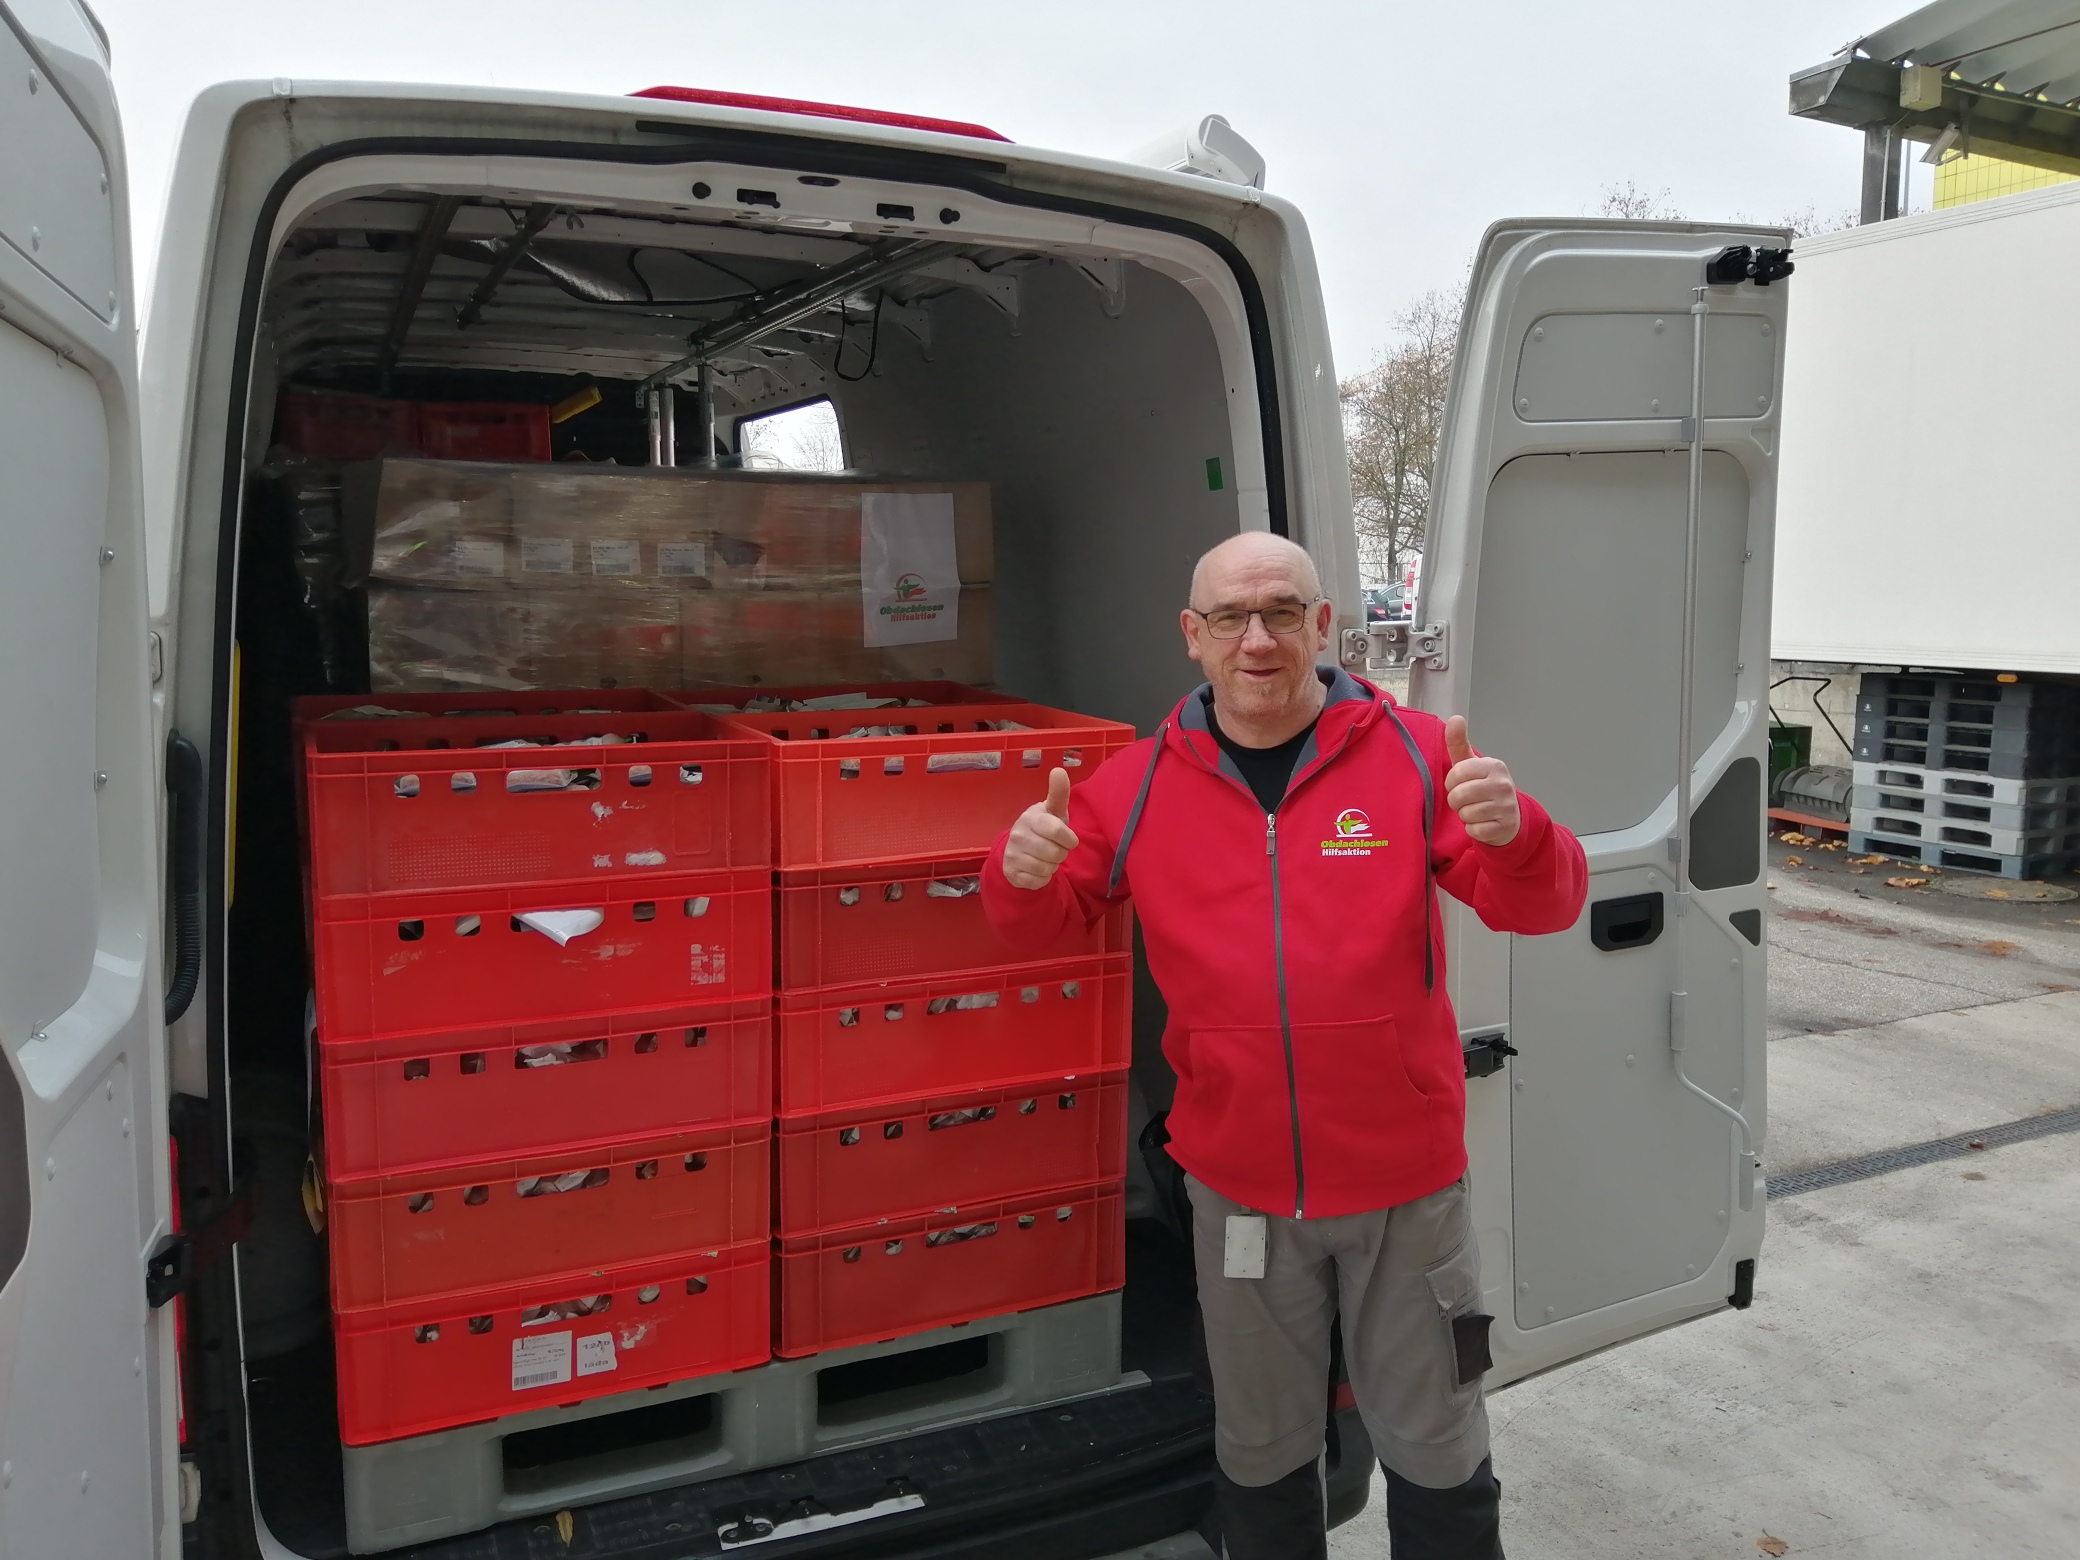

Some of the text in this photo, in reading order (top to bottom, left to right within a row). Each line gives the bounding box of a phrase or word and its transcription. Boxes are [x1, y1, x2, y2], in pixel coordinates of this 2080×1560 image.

[880, 604, 944, 615] Obdachlosen
[891, 612, 936, 622] Hilfsaktion
[1321, 840, 1389, 848] Obdachlosen
[1322, 848, 1371, 856] Hilfsaktion
